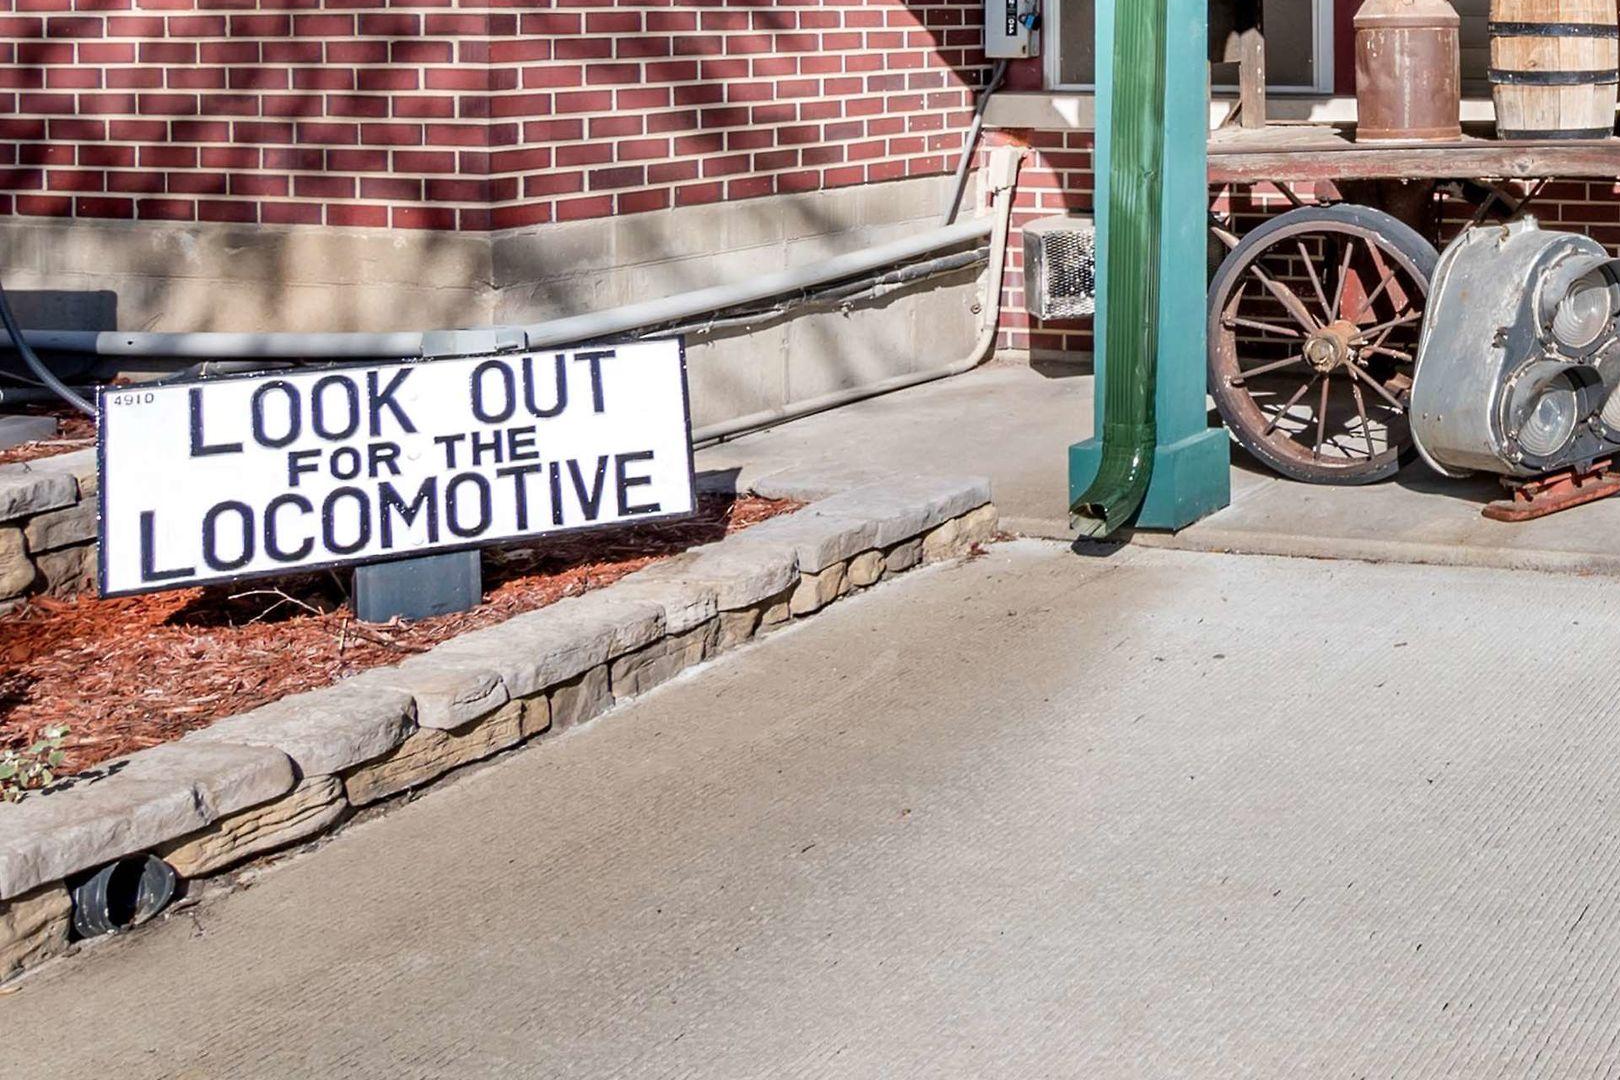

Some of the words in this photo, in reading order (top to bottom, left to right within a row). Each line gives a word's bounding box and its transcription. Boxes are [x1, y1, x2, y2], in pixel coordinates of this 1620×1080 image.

[113, 392, 155, 406] 4910
[188, 367, 418, 458] LOOK
[470, 349, 616, 424] OUT
[287, 441, 402, 488] FOR
[433, 425, 540, 469] THE
[140, 450, 662, 583] LOCOMOTIVE
